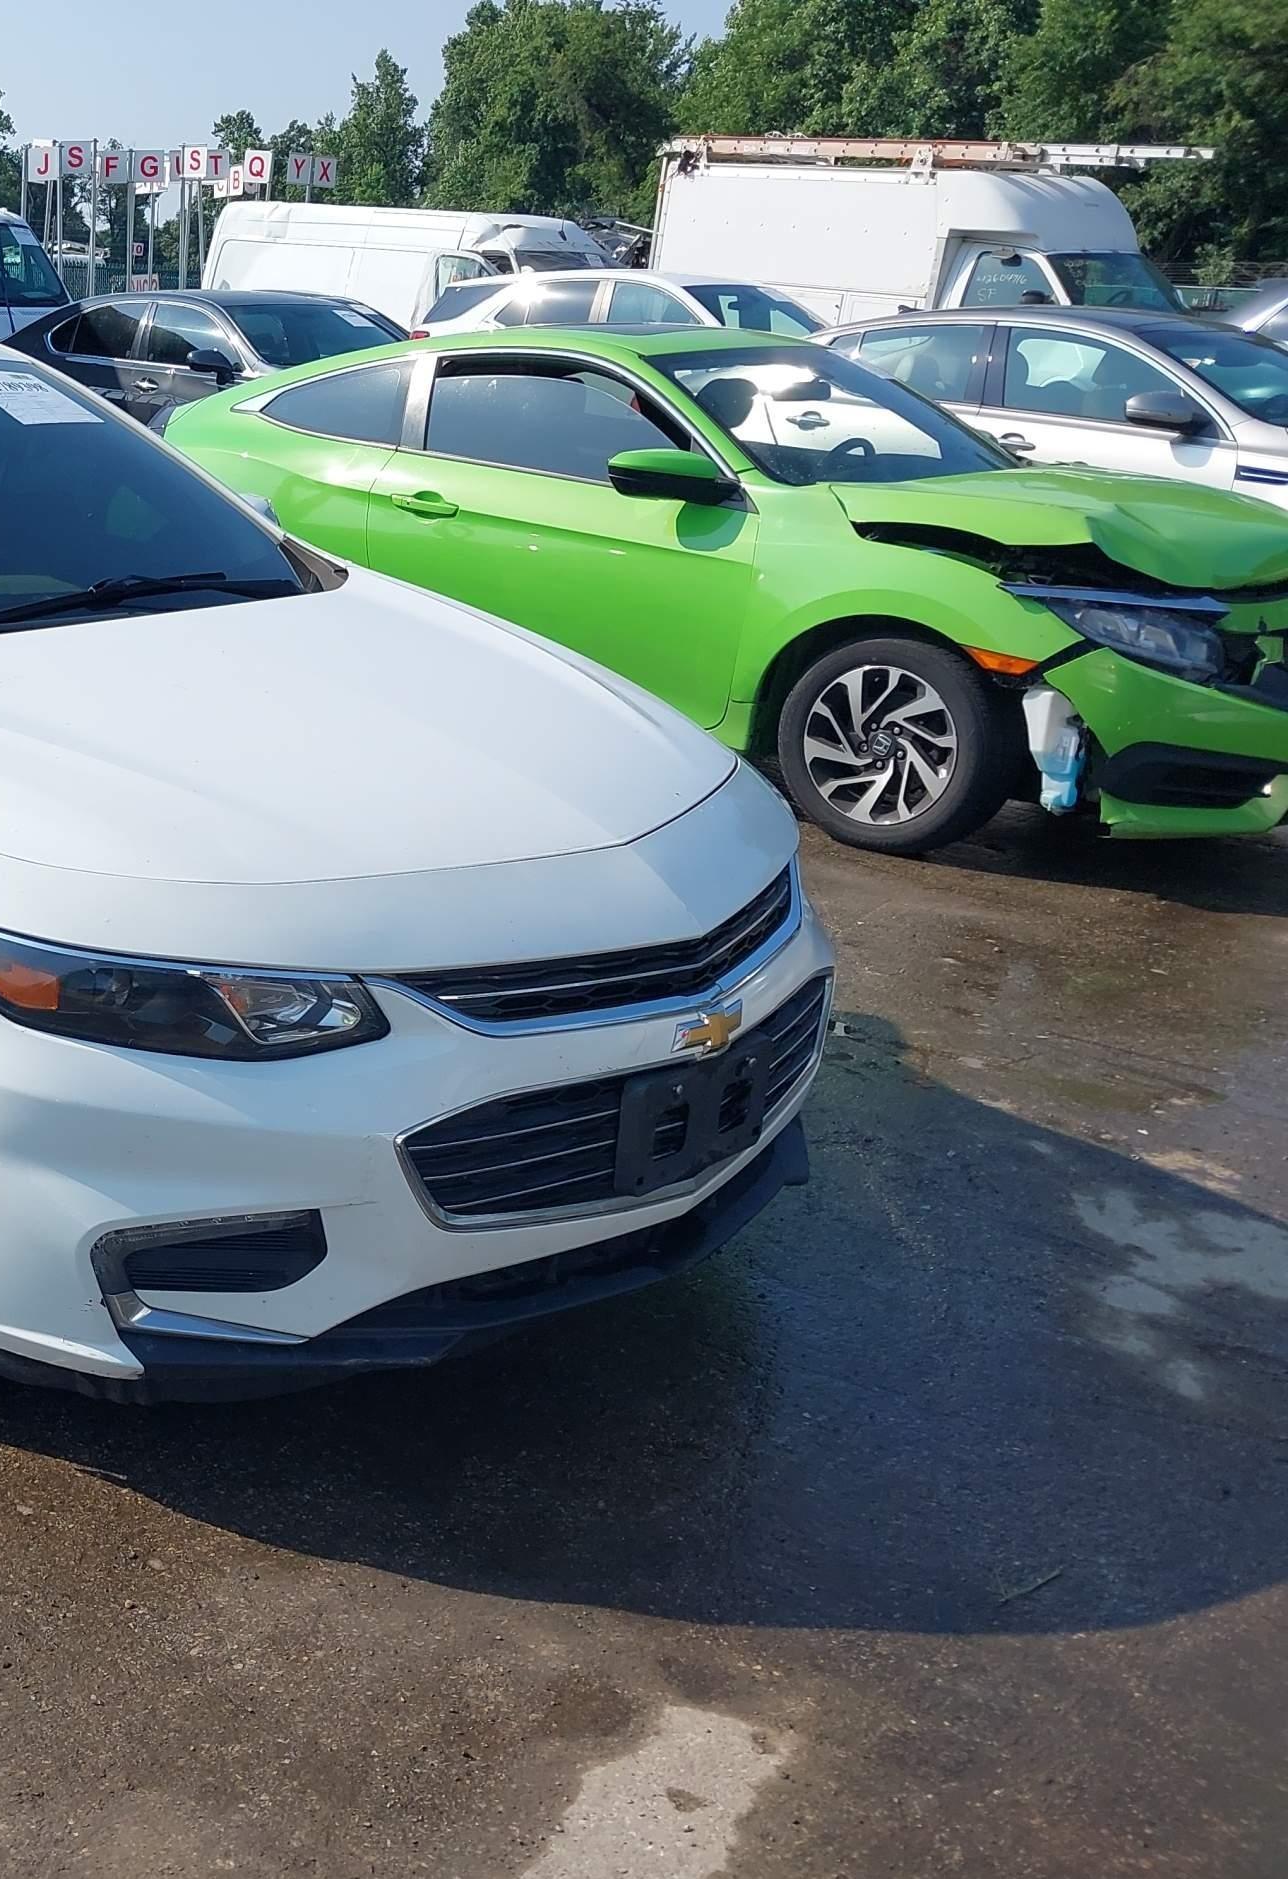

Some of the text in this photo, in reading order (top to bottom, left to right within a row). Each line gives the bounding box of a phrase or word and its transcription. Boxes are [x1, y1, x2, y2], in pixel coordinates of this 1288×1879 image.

[37, 153, 49, 175] J
[67, 146, 84, 168] S
[105, 156, 119, 177] F
[140, 155, 159, 177] G
[189, 150, 201, 171] S
[209, 155, 223, 175] T
[249, 156, 264, 178] Q
[293, 158, 306, 179] Y
[319, 161, 331, 182] X
